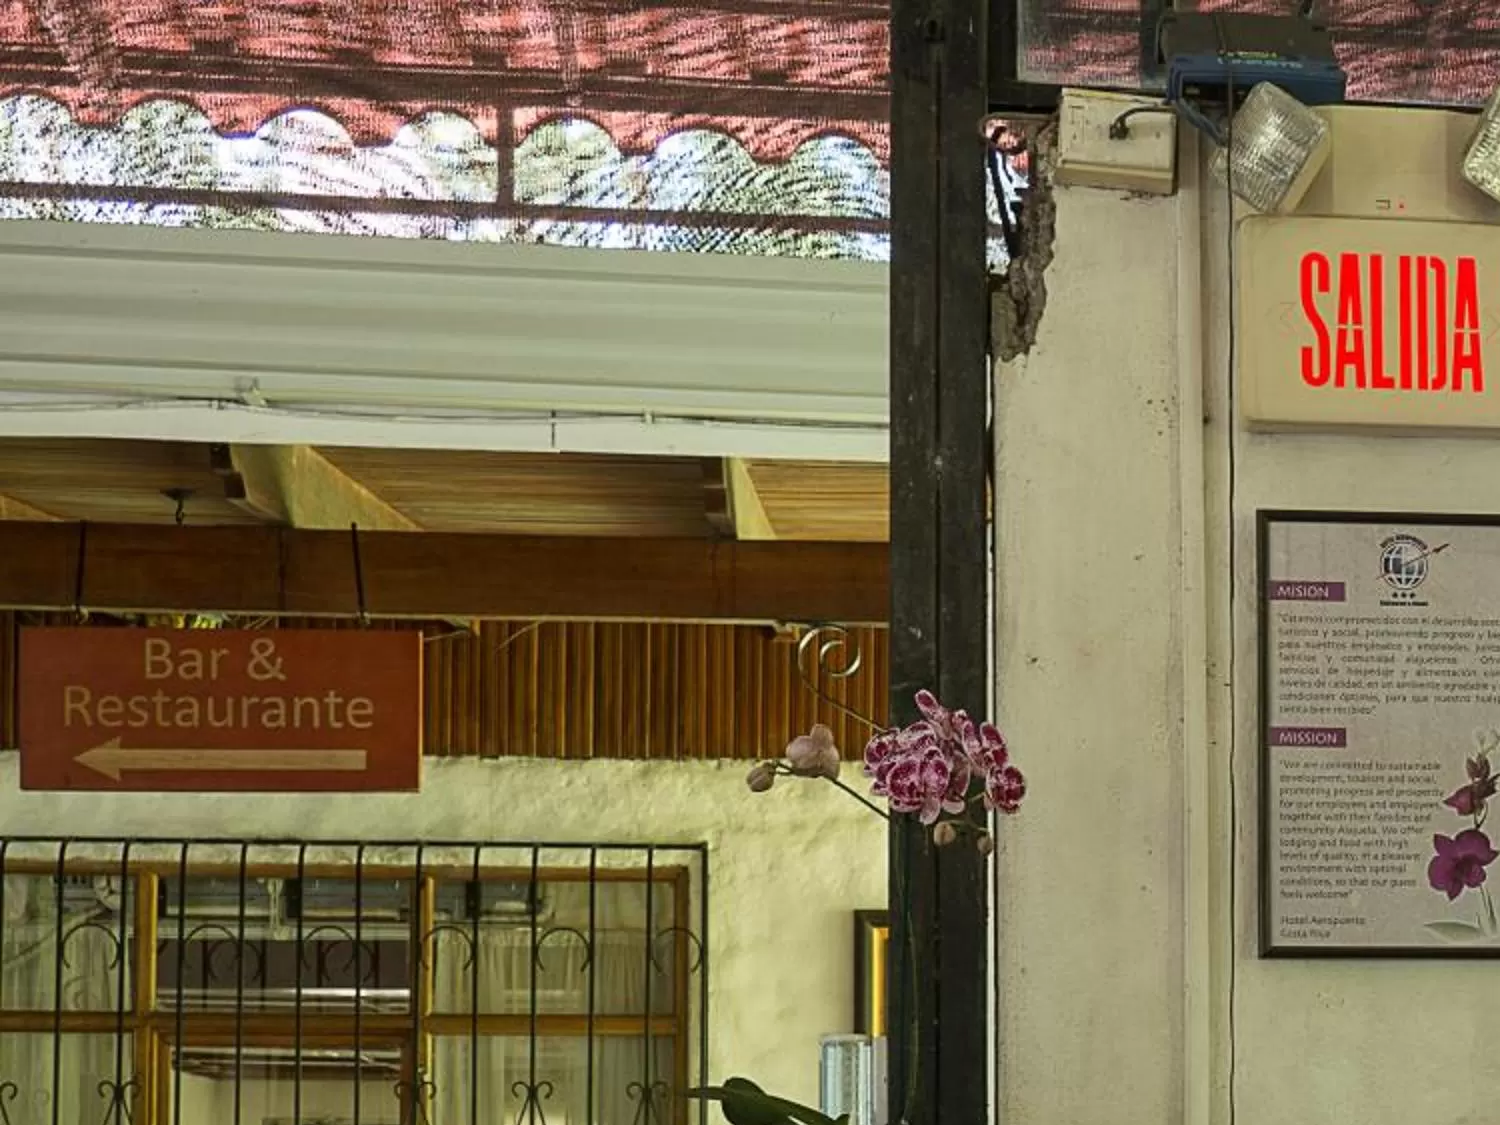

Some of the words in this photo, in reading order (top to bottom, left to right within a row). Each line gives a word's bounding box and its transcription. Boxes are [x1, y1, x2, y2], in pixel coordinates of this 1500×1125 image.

[1300, 252, 1484, 393] SALIDA
[145, 638, 229, 680] Bar
[246, 636, 287, 681] &
[63, 685, 374, 729] Restaurante
[1279, 732, 1337, 745] MISSION
